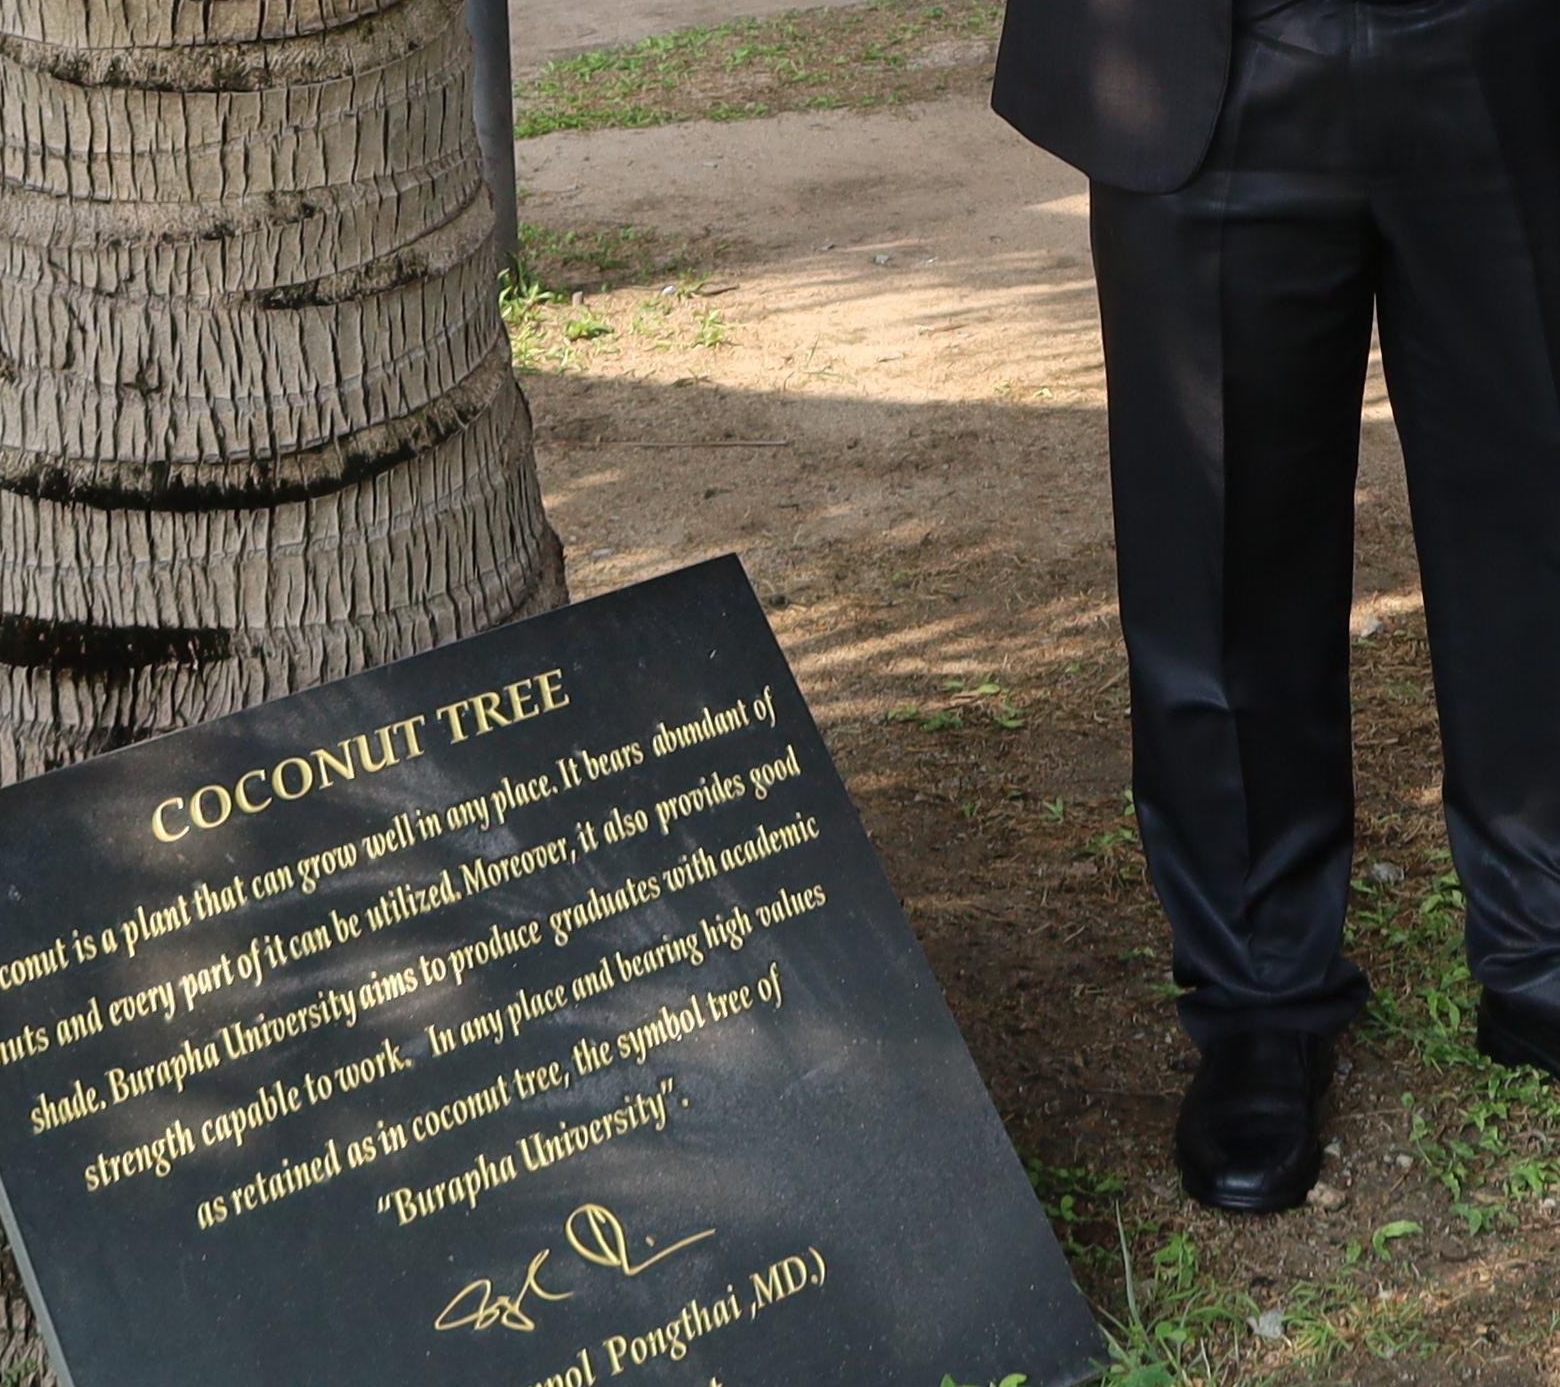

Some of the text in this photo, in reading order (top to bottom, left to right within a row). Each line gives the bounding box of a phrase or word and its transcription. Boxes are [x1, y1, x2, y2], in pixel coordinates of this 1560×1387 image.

[72, 930, 98, 962] is
[101, 927, 119, 954] a
[120, 894, 192, 957] plant
[191, 876, 248, 920] that
[251, 866, 295, 900] can
[296, 842, 357, 895] grow
[361, 813, 416, 860] well
[415, 810, 443, 839] in
[446, 797, 490, 829] any
[490, 774, 559, 821] place.
[557, 758, 583, 787] It
[579, 742, 644, 780] bears
[652, 701, 750, 756] abundant
[751, 684, 778, 728] of
[148, 667, 571, 843] COCONUT TREE
[30, 813, 819, 1134] shade. Burapha University aims to produce graduates with academic
[56, 997, 104, 1046] and
[108, 980, 177, 1027] every
[174, 954, 236, 1010] part
[236, 938, 263, 988] of
[263, 935, 289, 968] it
[289, 925, 333, 960] can
[334, 909, 363, 945] be
[365, 869, 463, 931] utilized.
[457, 837, 580, 897] Moreover,
[578, 822, 599, 852] it
[603, 809, 649, 843] also
[654, 772, 746, 833] provides
[749, 746, 801, 800] good
[84, 885, 826, 1192] strength capable to work. In any place and bearing high values
[197, 960, 784, 1229] as retained as in coconut tree, the symbol tree of
[603, 1286, 743, 1375] Pongthai
